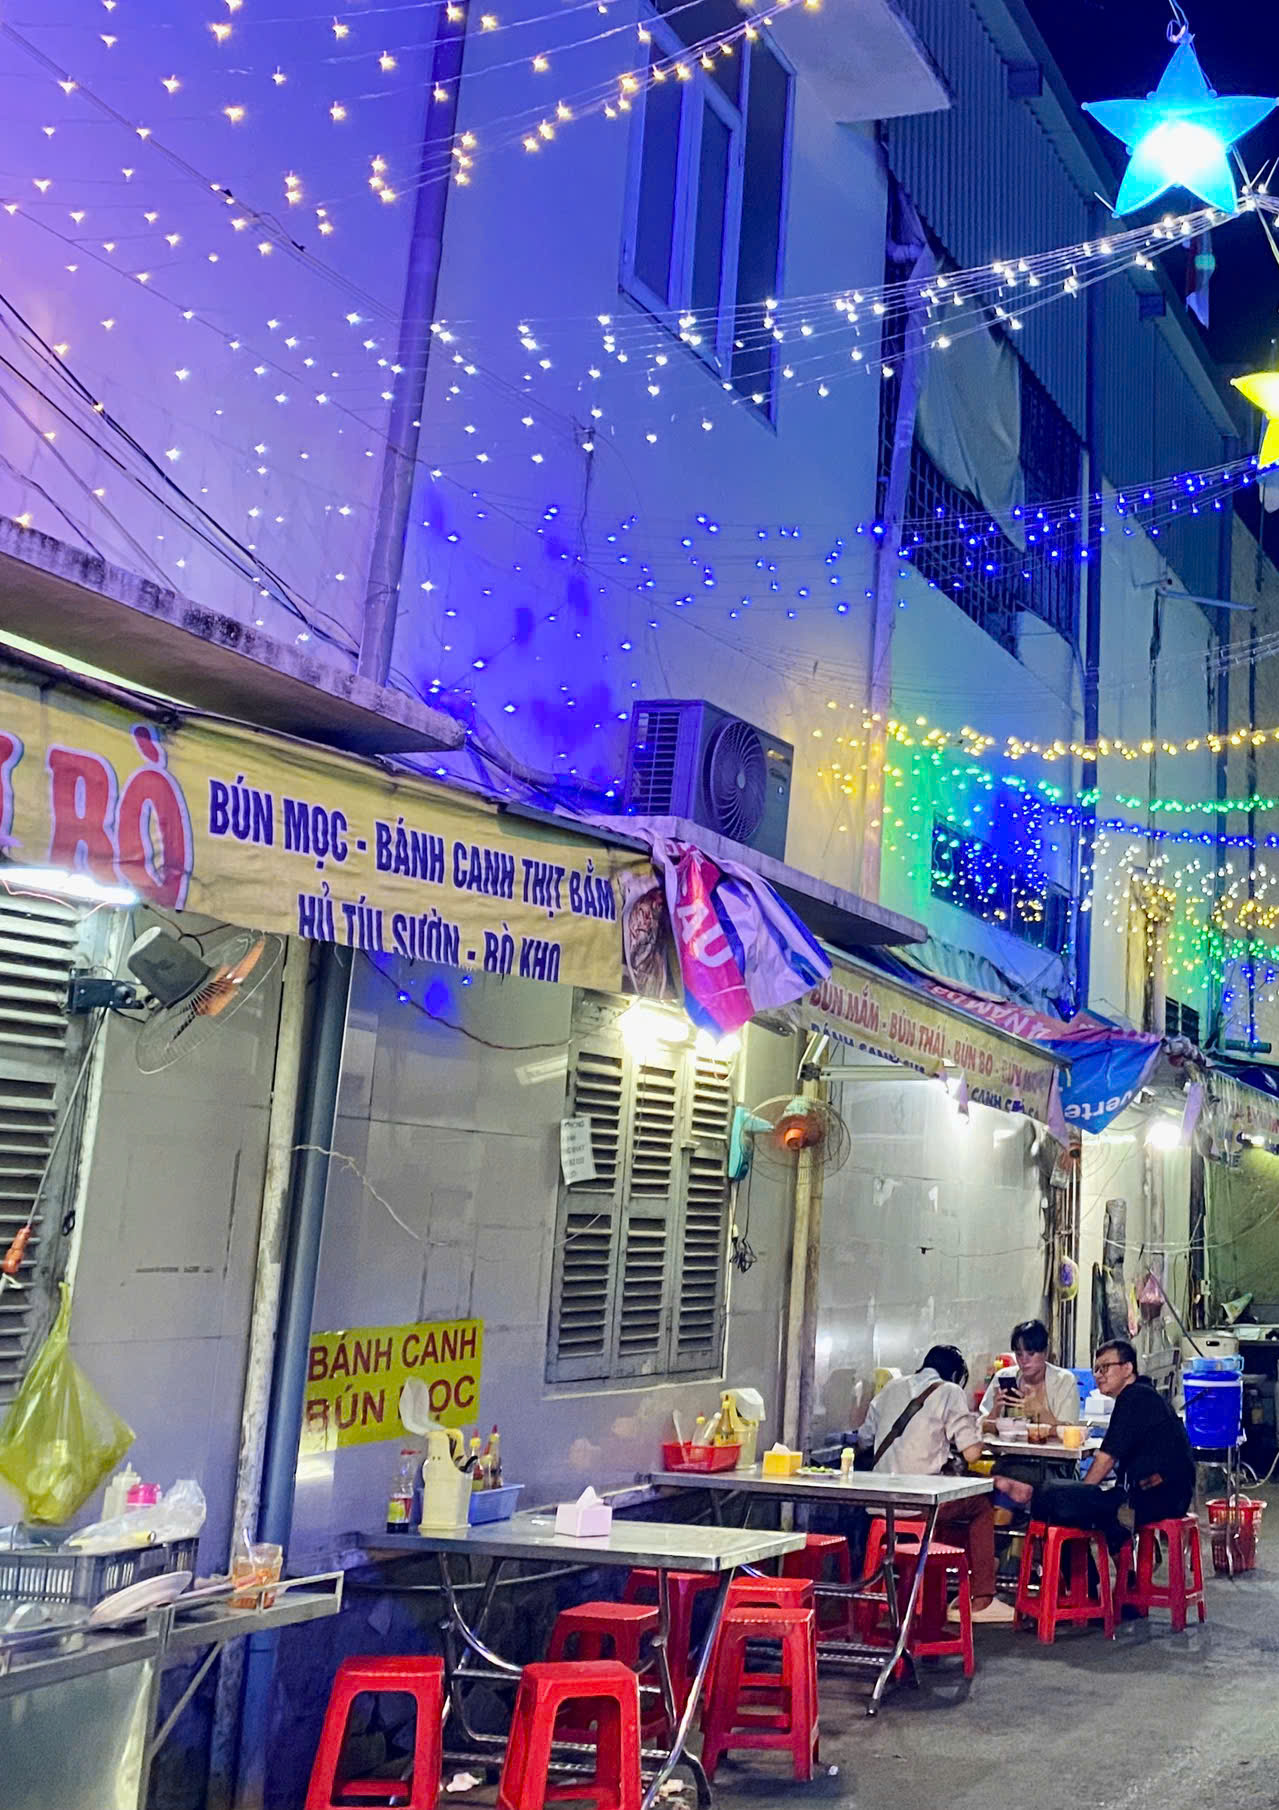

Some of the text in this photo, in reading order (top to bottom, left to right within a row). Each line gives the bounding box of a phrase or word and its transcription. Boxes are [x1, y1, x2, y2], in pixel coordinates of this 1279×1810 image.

[209, 775, 274, 846] BÚN
[282, 797, 349, 869] MỌC
[375, 817, 445, 884] BÁNH
[452, 841, 515, 900] CANH
[521, 858, 566, 918] THỊT
[568, 858, 616, 921] BẰM
[889, 1009, 917, 1048] BÚN
[307, 1326, 477, 1382] BÁNH CANH
[399, 1375, 475, 1421] ỌC
